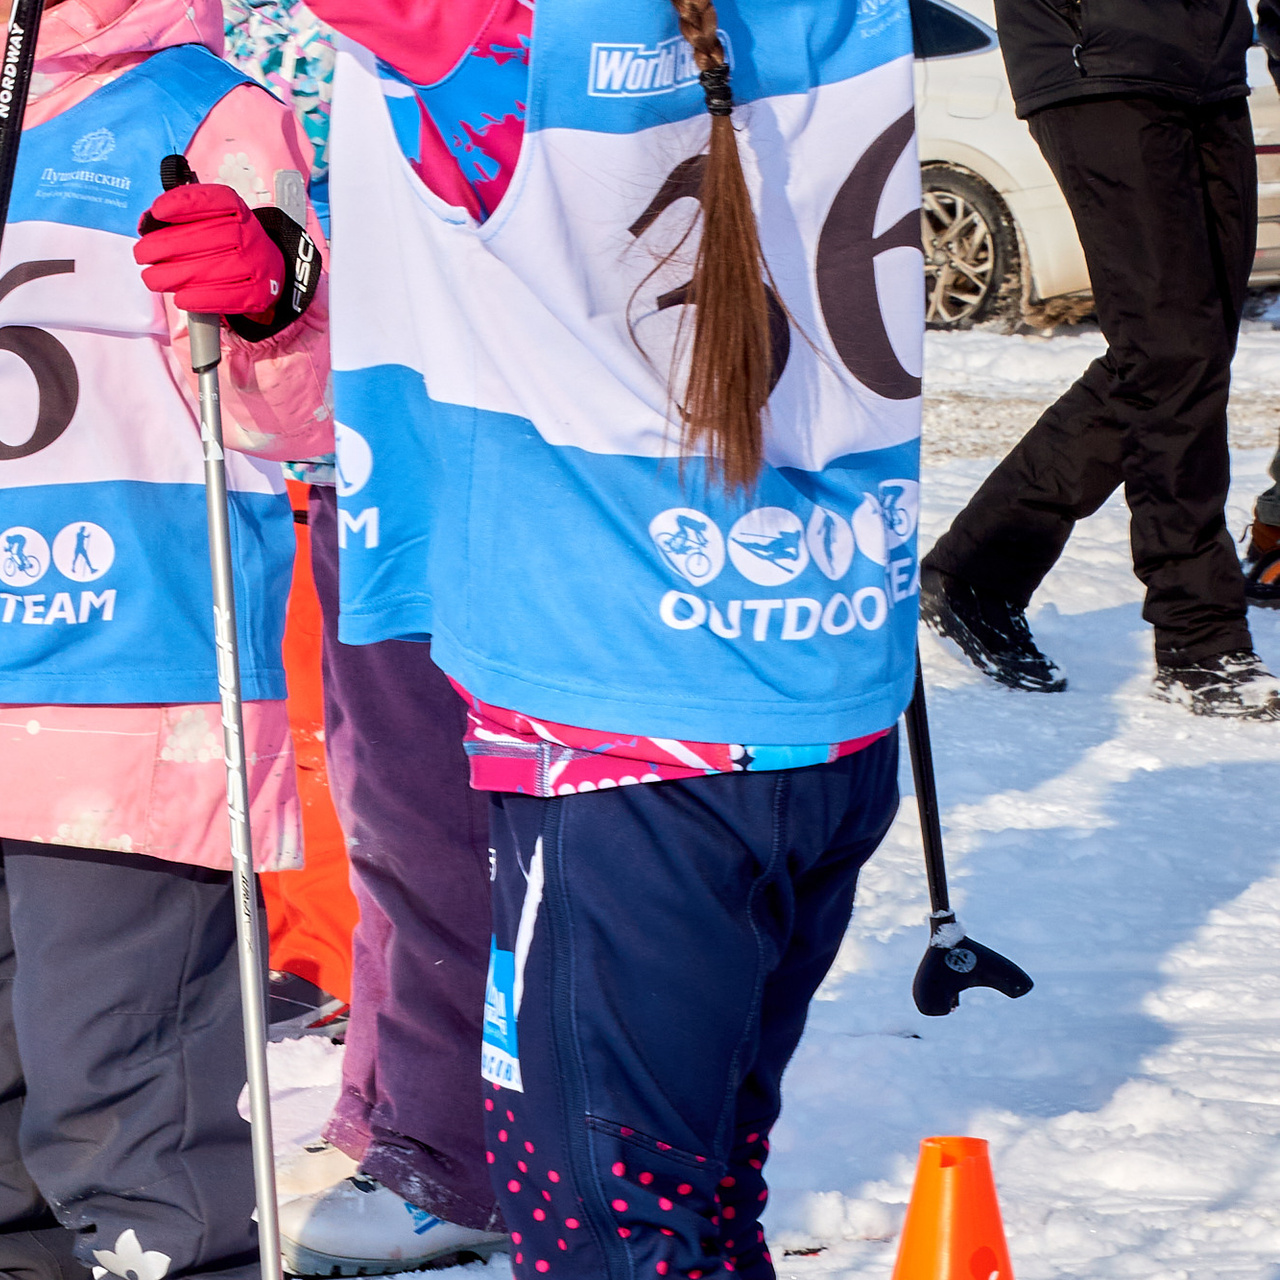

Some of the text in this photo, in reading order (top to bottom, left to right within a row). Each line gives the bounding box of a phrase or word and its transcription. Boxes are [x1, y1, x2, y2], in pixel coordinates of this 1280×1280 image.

[596, 45, 676, 90] World
[41, 168, 131, 190] Пушкинский
[659, 586, 888, 641] OUTDOO
[214, 605, 248, 862] FISCHER
